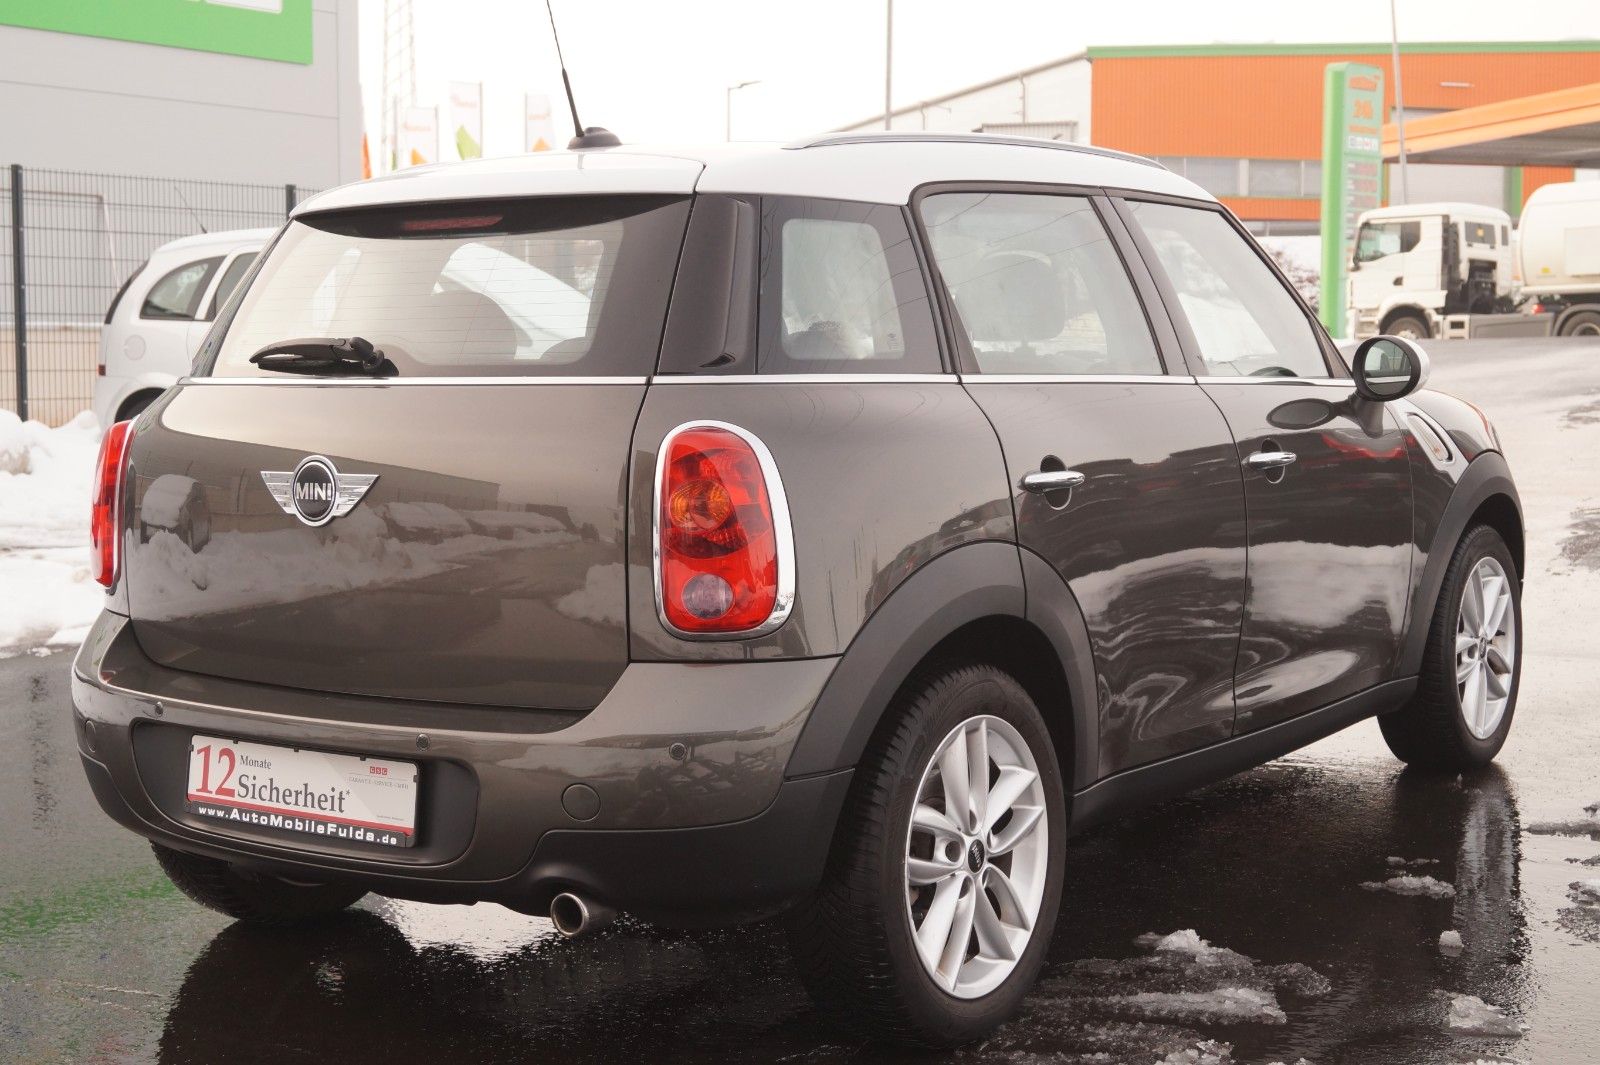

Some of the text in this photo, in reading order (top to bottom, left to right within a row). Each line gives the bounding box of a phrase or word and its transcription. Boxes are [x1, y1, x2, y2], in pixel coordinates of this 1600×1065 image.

[296, 482, 332, 501] MINI
[195, 745, 236, 798] 12
[240, 755, 272, 770] Monate
